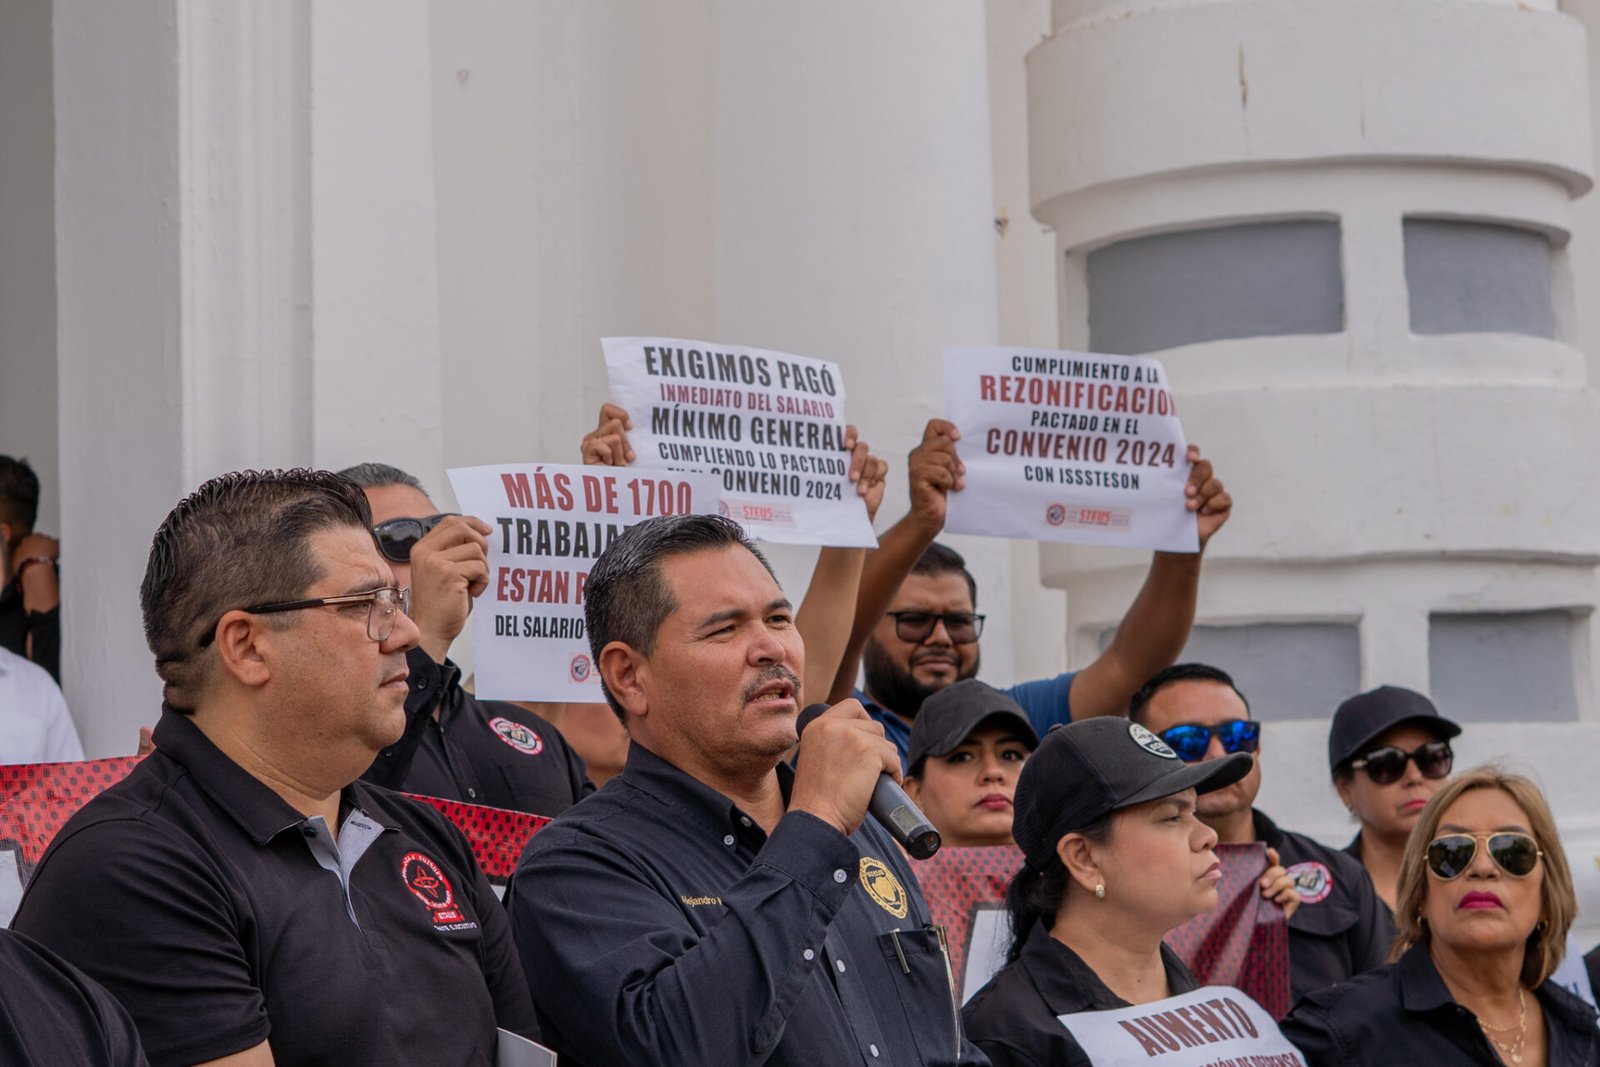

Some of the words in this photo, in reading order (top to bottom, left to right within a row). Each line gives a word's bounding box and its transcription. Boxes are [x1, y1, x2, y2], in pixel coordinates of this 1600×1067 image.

[643, 346, 772, 387] EXIGIMOS
[777, 360, 836, 397] PAGÓ
[1012, 356, 1130, 381] CUMPLIMIENTO
[1134, 366, 1142, 383] A
[1147, 367, 1159, 384] LA
[660, 383, 742, 409] INMEDIATO
[748, 392, 772, 412] DEL
[777, 395, 834, 419] SALARIO
[652, 404, 742, 442] MÍNIMO
[750, 416, 847, 452] GENERAL
[1031, 410, 1098, 432] PACTADO
[1103, 417, 1120, 433] EN
[1125, 418, 1139, 435] EL
[659, 442, 755, 468] CUMPLIENDO
[759, 452, 776, 470] LO
[781, 454, 846, 476] PACTADO
[986, 428, 1107, 463] CONVENIO
[1116, 438, 1175, 468] 2024
[501, 466, 574, 511] MÁS
[583, 474, 619, 514] DE
[627, 478, 692, 517] 1700
[806, 480, 842, 501] 2024
[1025, 465, 1054, 483] CON
[1060, 468, 1140, 490] ISSSTESON
[742, 505, 773, 519] STEUS
[497, 517, 635, 559] TRABAJA
[497, 566, 570, 605] ESTAN
[495, 614, 519, 637] DEL
[523, 615, 584, 640] SALARIO
[1117, 997, 1259, 1057] AUMENTO
